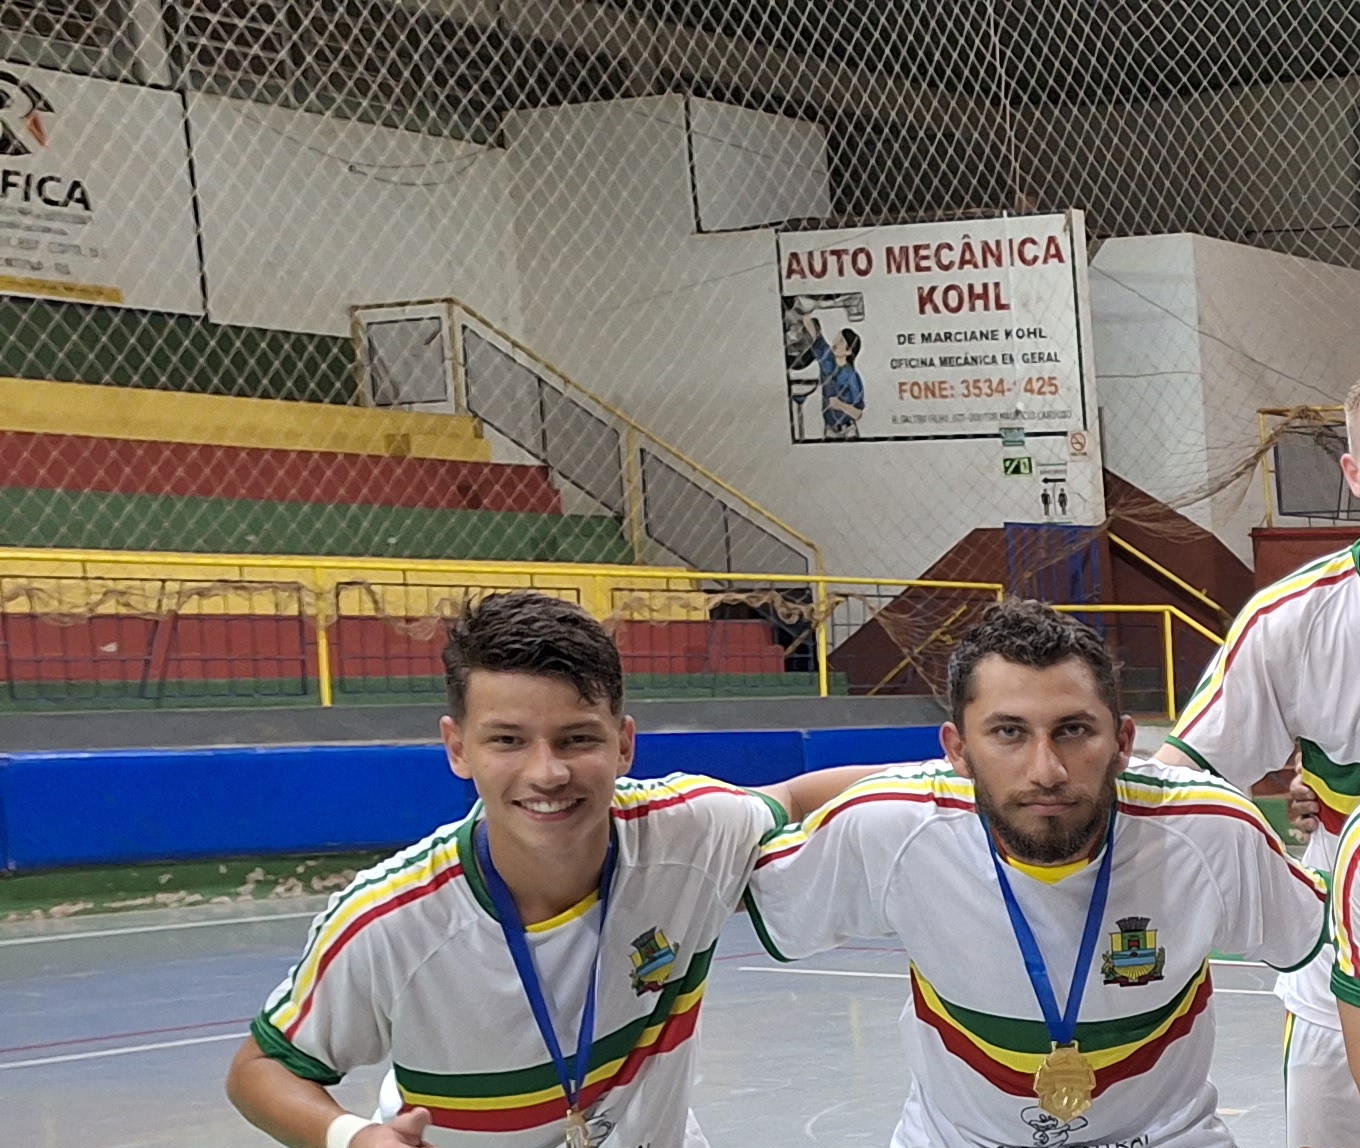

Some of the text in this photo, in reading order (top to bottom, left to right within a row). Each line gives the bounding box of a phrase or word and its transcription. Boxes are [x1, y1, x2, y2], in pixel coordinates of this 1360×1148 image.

[785, 234, 1065, 280] AUTO MECÂNICA
[917, 281, 1011, 315] KOHL
[897, 328, 1048, 345] DE MARCIANE KOHL
[890, 358, 936, 370] OFICINA
[1021, 352, 1061, 364] GERAL
[898, 380, 955, 401] FONE:
